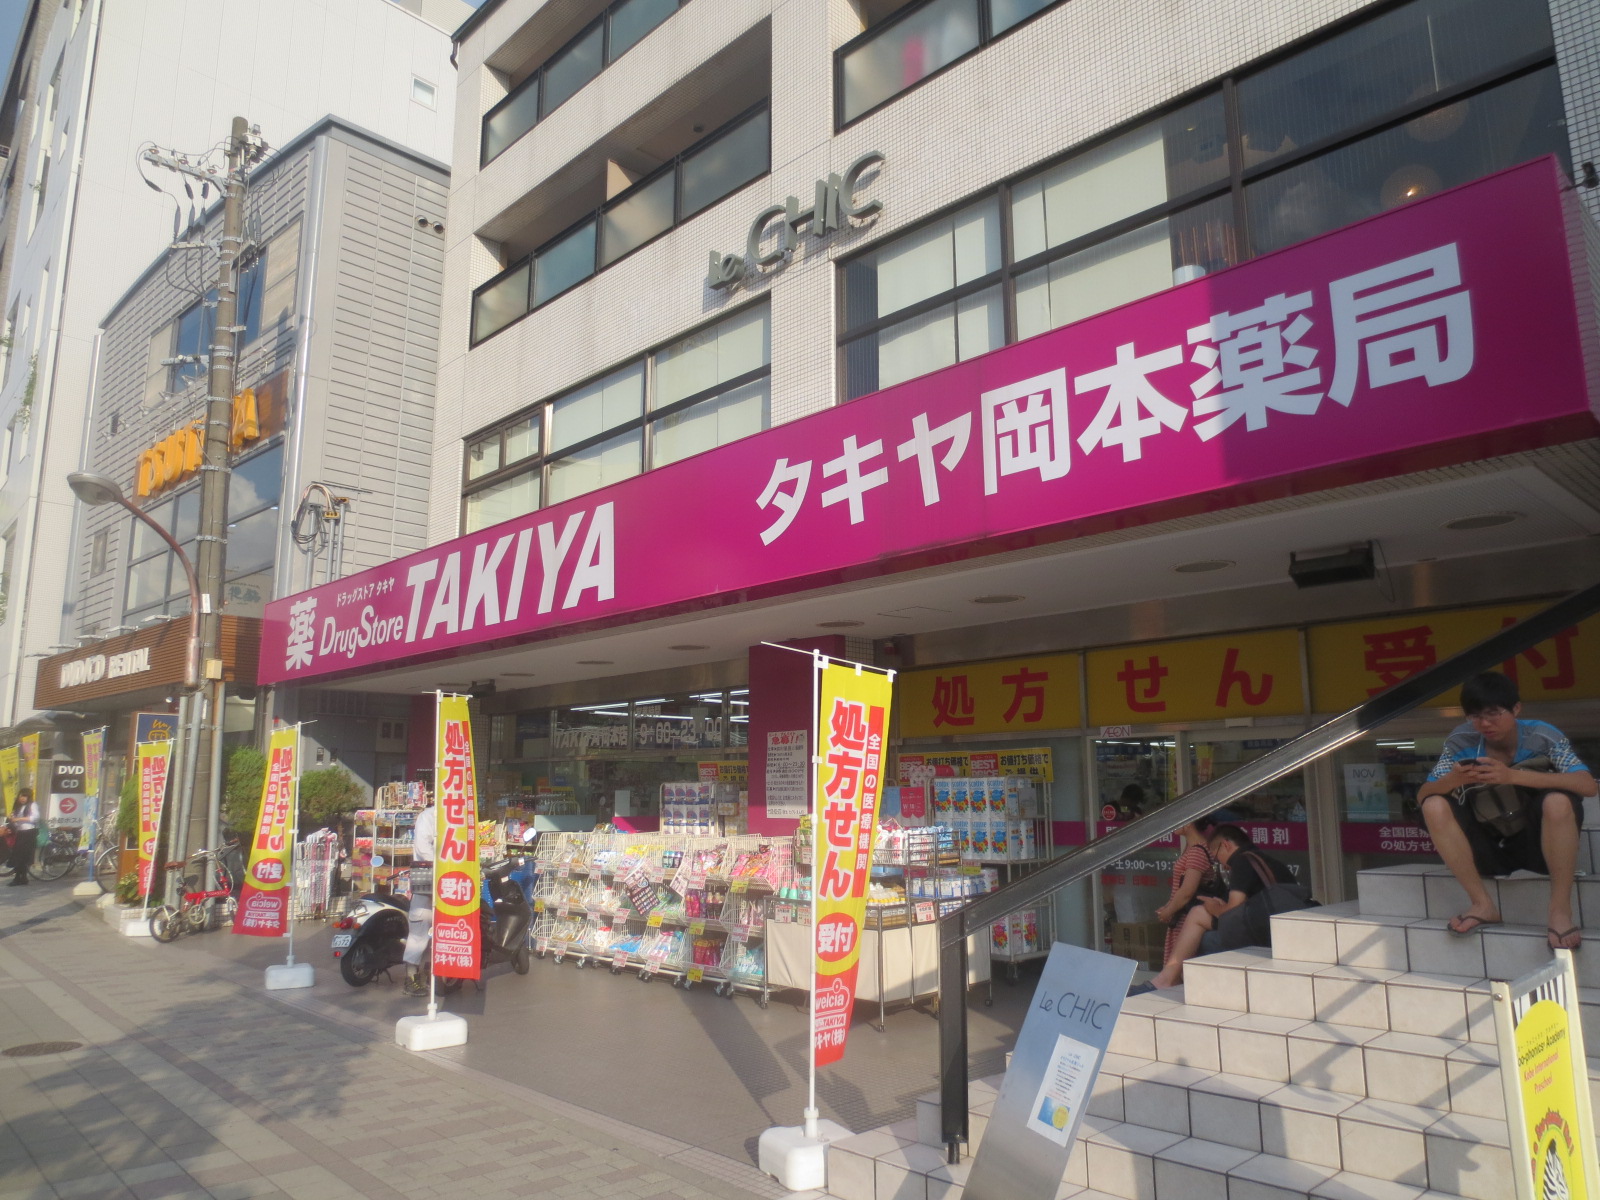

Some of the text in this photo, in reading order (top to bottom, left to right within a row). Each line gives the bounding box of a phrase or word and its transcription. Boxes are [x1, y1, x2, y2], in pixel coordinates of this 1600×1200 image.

[747, 150, 886, 266] CHIC
[755, 242, 1475, 546] タキヤ岡本薬局
[404, 501, 615, 643] TAKIYA
[337, 577, 395, 608] ドラッグストア タキヤ
[284, 597, 318, 671] 薬
[58, 765, 84, 775] DVD
[970, 759, 997, 770] BEST
[1352, 769, 1376, 778] NOV
[61, 779, 79, 789] CD
[440, 720, 466, 862] 処方せん
[819, 696, 869, 900] 処方せん
[856, 733, 881, 870] 全国の医療機関
[1381, 840, 1440, 852] の処方せ
[441, 878, 473, 901] 受付
[437, 926, 468, 940] welcia
[818, 922, 854, 954] 受付
[1057, 992, 1110, 1030] CHIC
